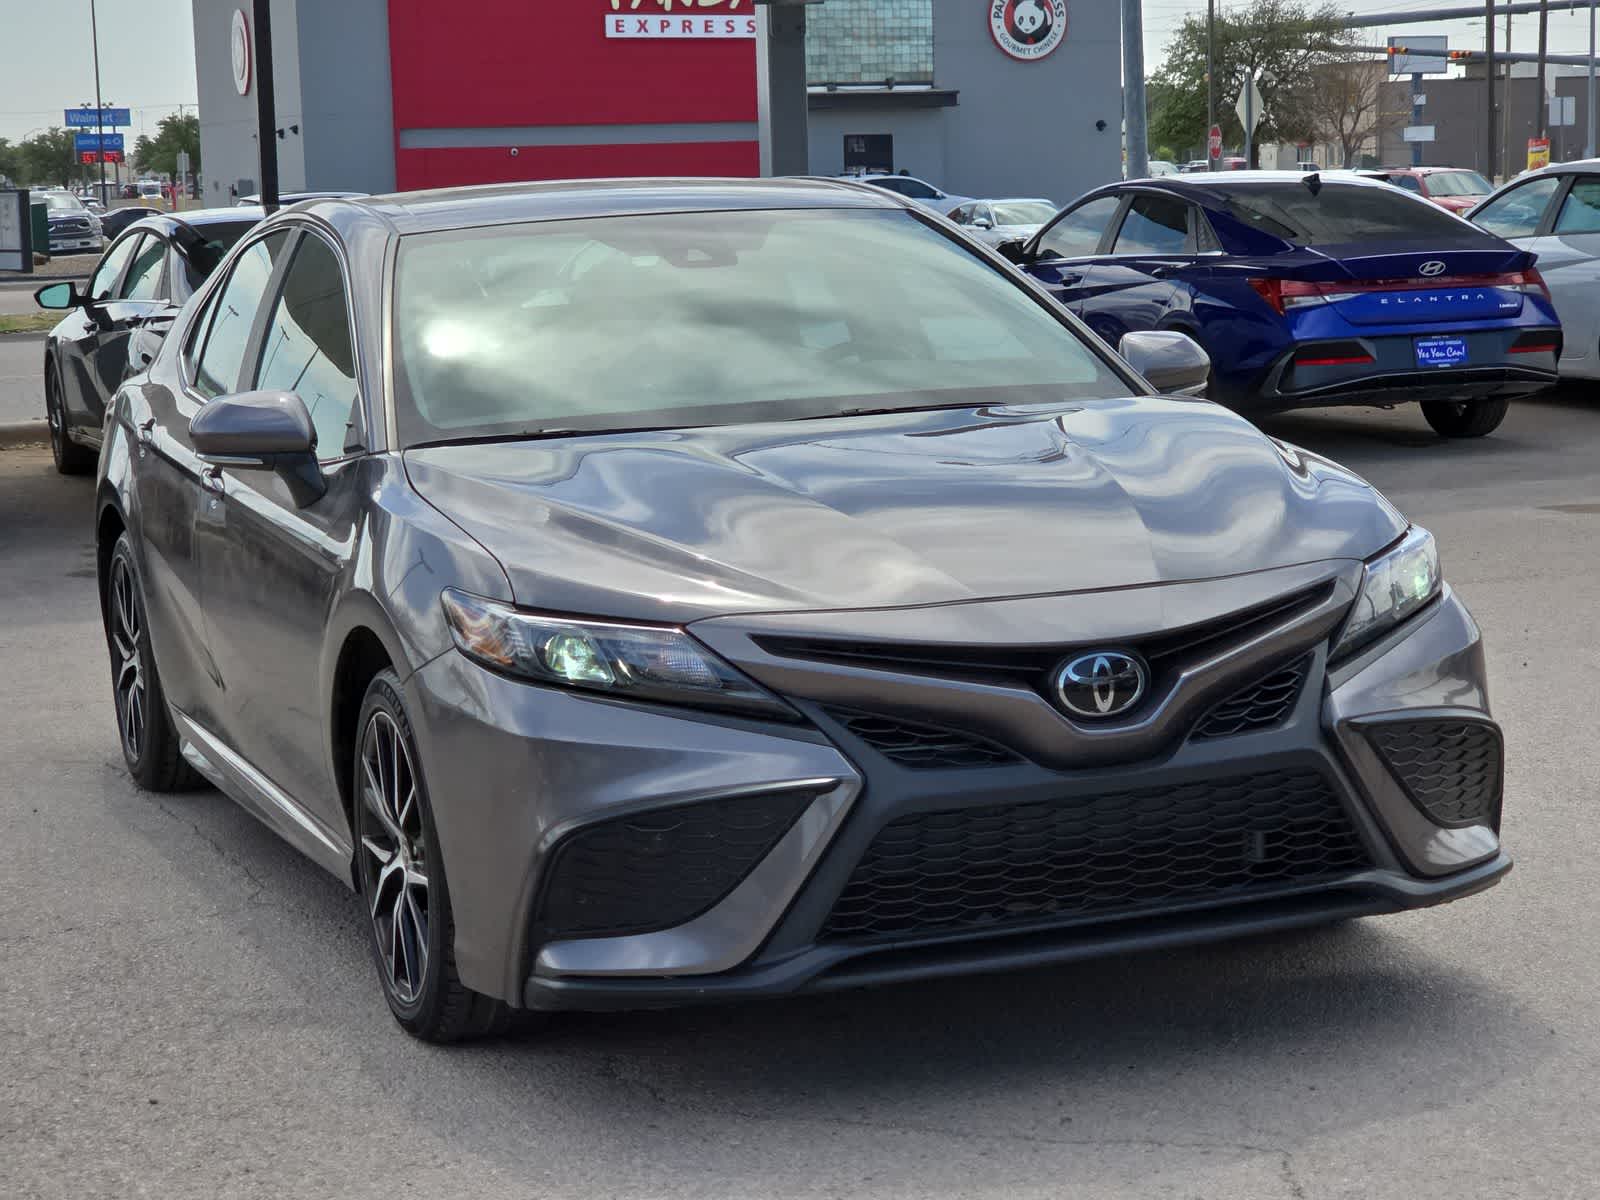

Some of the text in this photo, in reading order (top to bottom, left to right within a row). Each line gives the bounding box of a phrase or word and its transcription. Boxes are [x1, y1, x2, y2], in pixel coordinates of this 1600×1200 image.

[615, 19, 756, 33] EXPRESS
[1000, 31, 1058, 55] GOURMET CHINESE
[1380, 294, 1484, 304] ELANTRA
[1417, 348, 1429, 359] Yes
[1430, 347, 1446, 358] You
